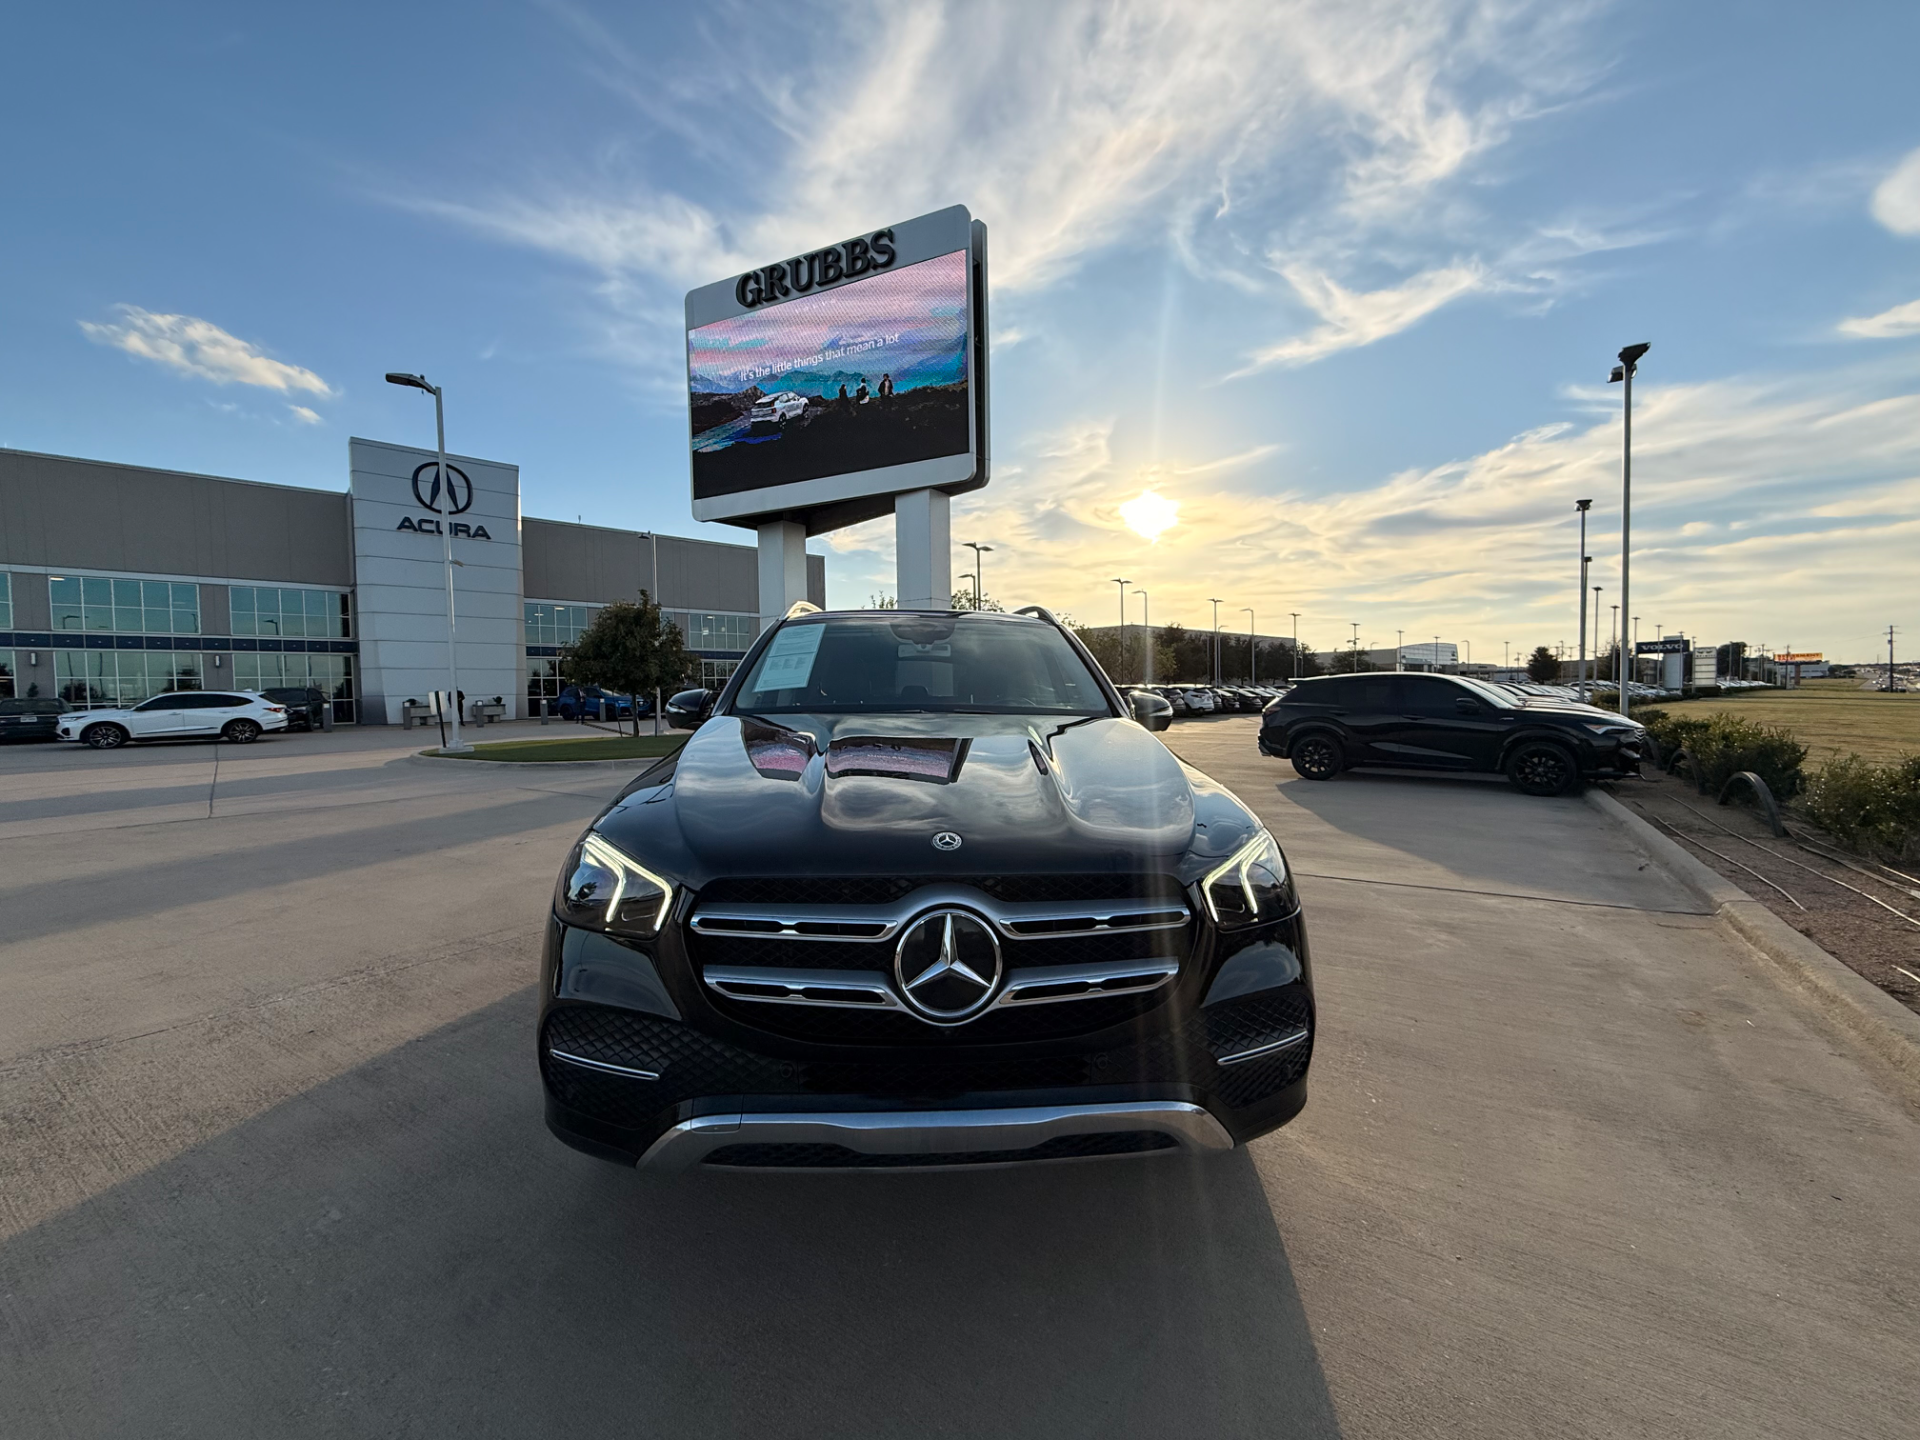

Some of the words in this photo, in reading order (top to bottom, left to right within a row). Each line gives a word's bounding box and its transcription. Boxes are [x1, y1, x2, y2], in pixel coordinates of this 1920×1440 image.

[736, 229, 895, 308] GRUBBS
[741, 370, 754, 381] It's
[756, 365, 771, 377] the
[772, 361, 793, 373] little
[794, 356, 824, 368] things
[825, 347, 846, 360] that
[847, 341, 875, 355] mean
[877, 338, 884, 347] a
[886, 332, 900, 344] lot
[396, 516, 492, 540] ACURA
